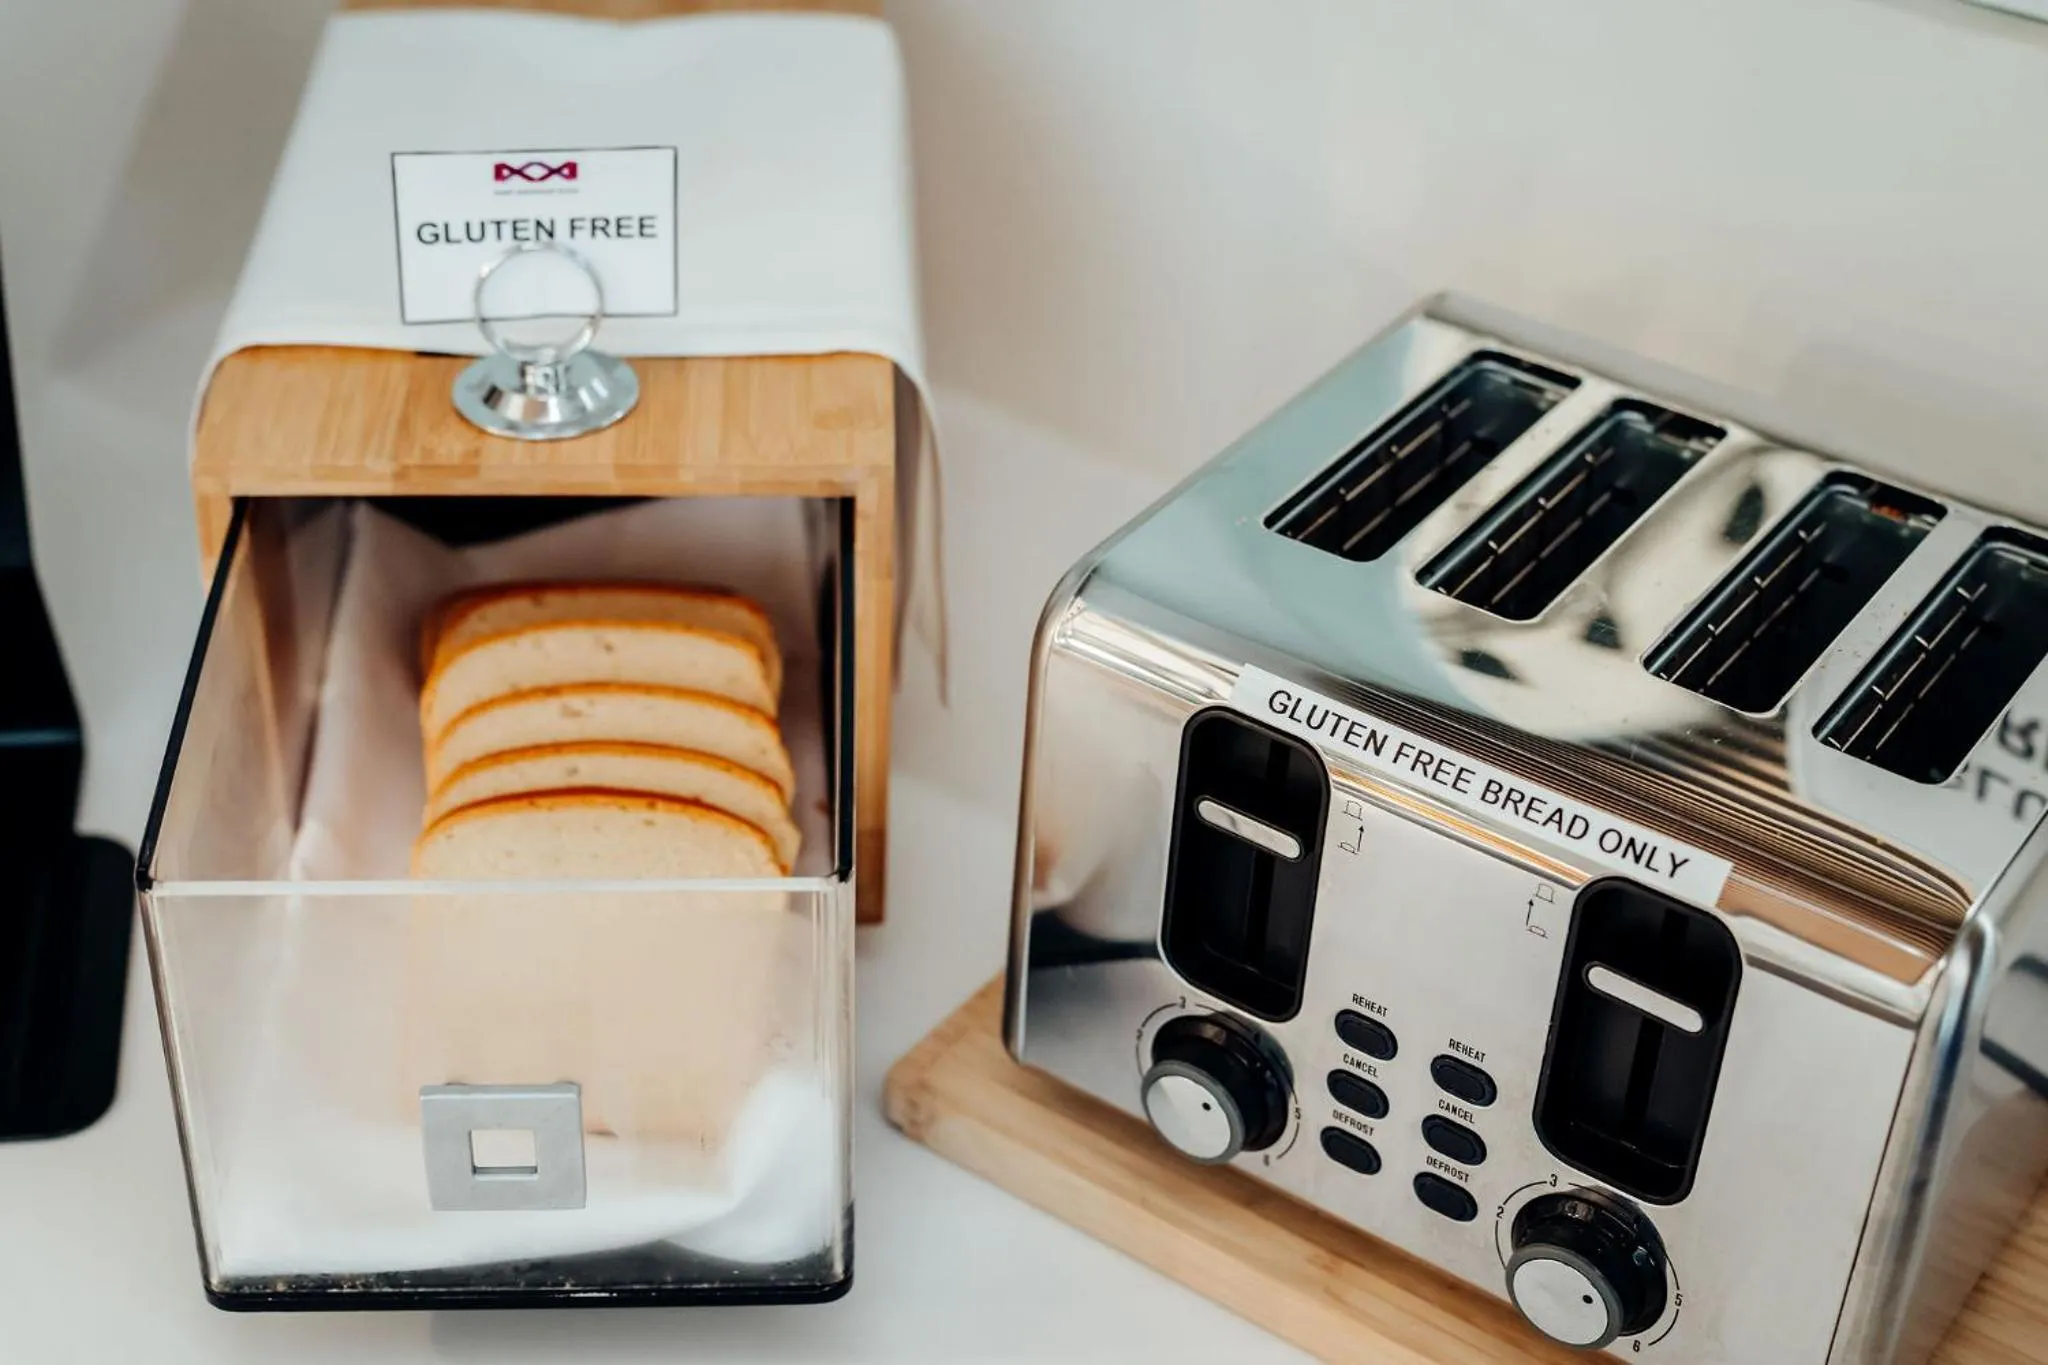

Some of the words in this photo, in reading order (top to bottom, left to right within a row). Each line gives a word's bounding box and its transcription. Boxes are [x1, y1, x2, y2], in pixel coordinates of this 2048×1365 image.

[416, 218, 556, 245] GLUTEN
[569, 215, 658, 239] FREE
[1268, 689, 1389, 757] GLUTEN
[1391, 742, 1476, 794] FREE
[1480, 779, 1591, 840] BREAD
[1598, 828, 1691, 879] ONLY
[1351, 993, 1389, 1018] REHEAT
[1448, 1038, 1486, 1063] REHEAT
[1342, 1053, 1379, 1078] CANCEL
[1332, 1109, 1376, 1137] DEFROST
[1438, 1098, 1476, 1124] CANCEL
[1425, 1155, 1471, 1183] DEFROST
[1549, 1174, 1559, 1187] 3
[1496, 1206, 1504, 1218] 2
[1674, 1294, 1683, 1307] 5
